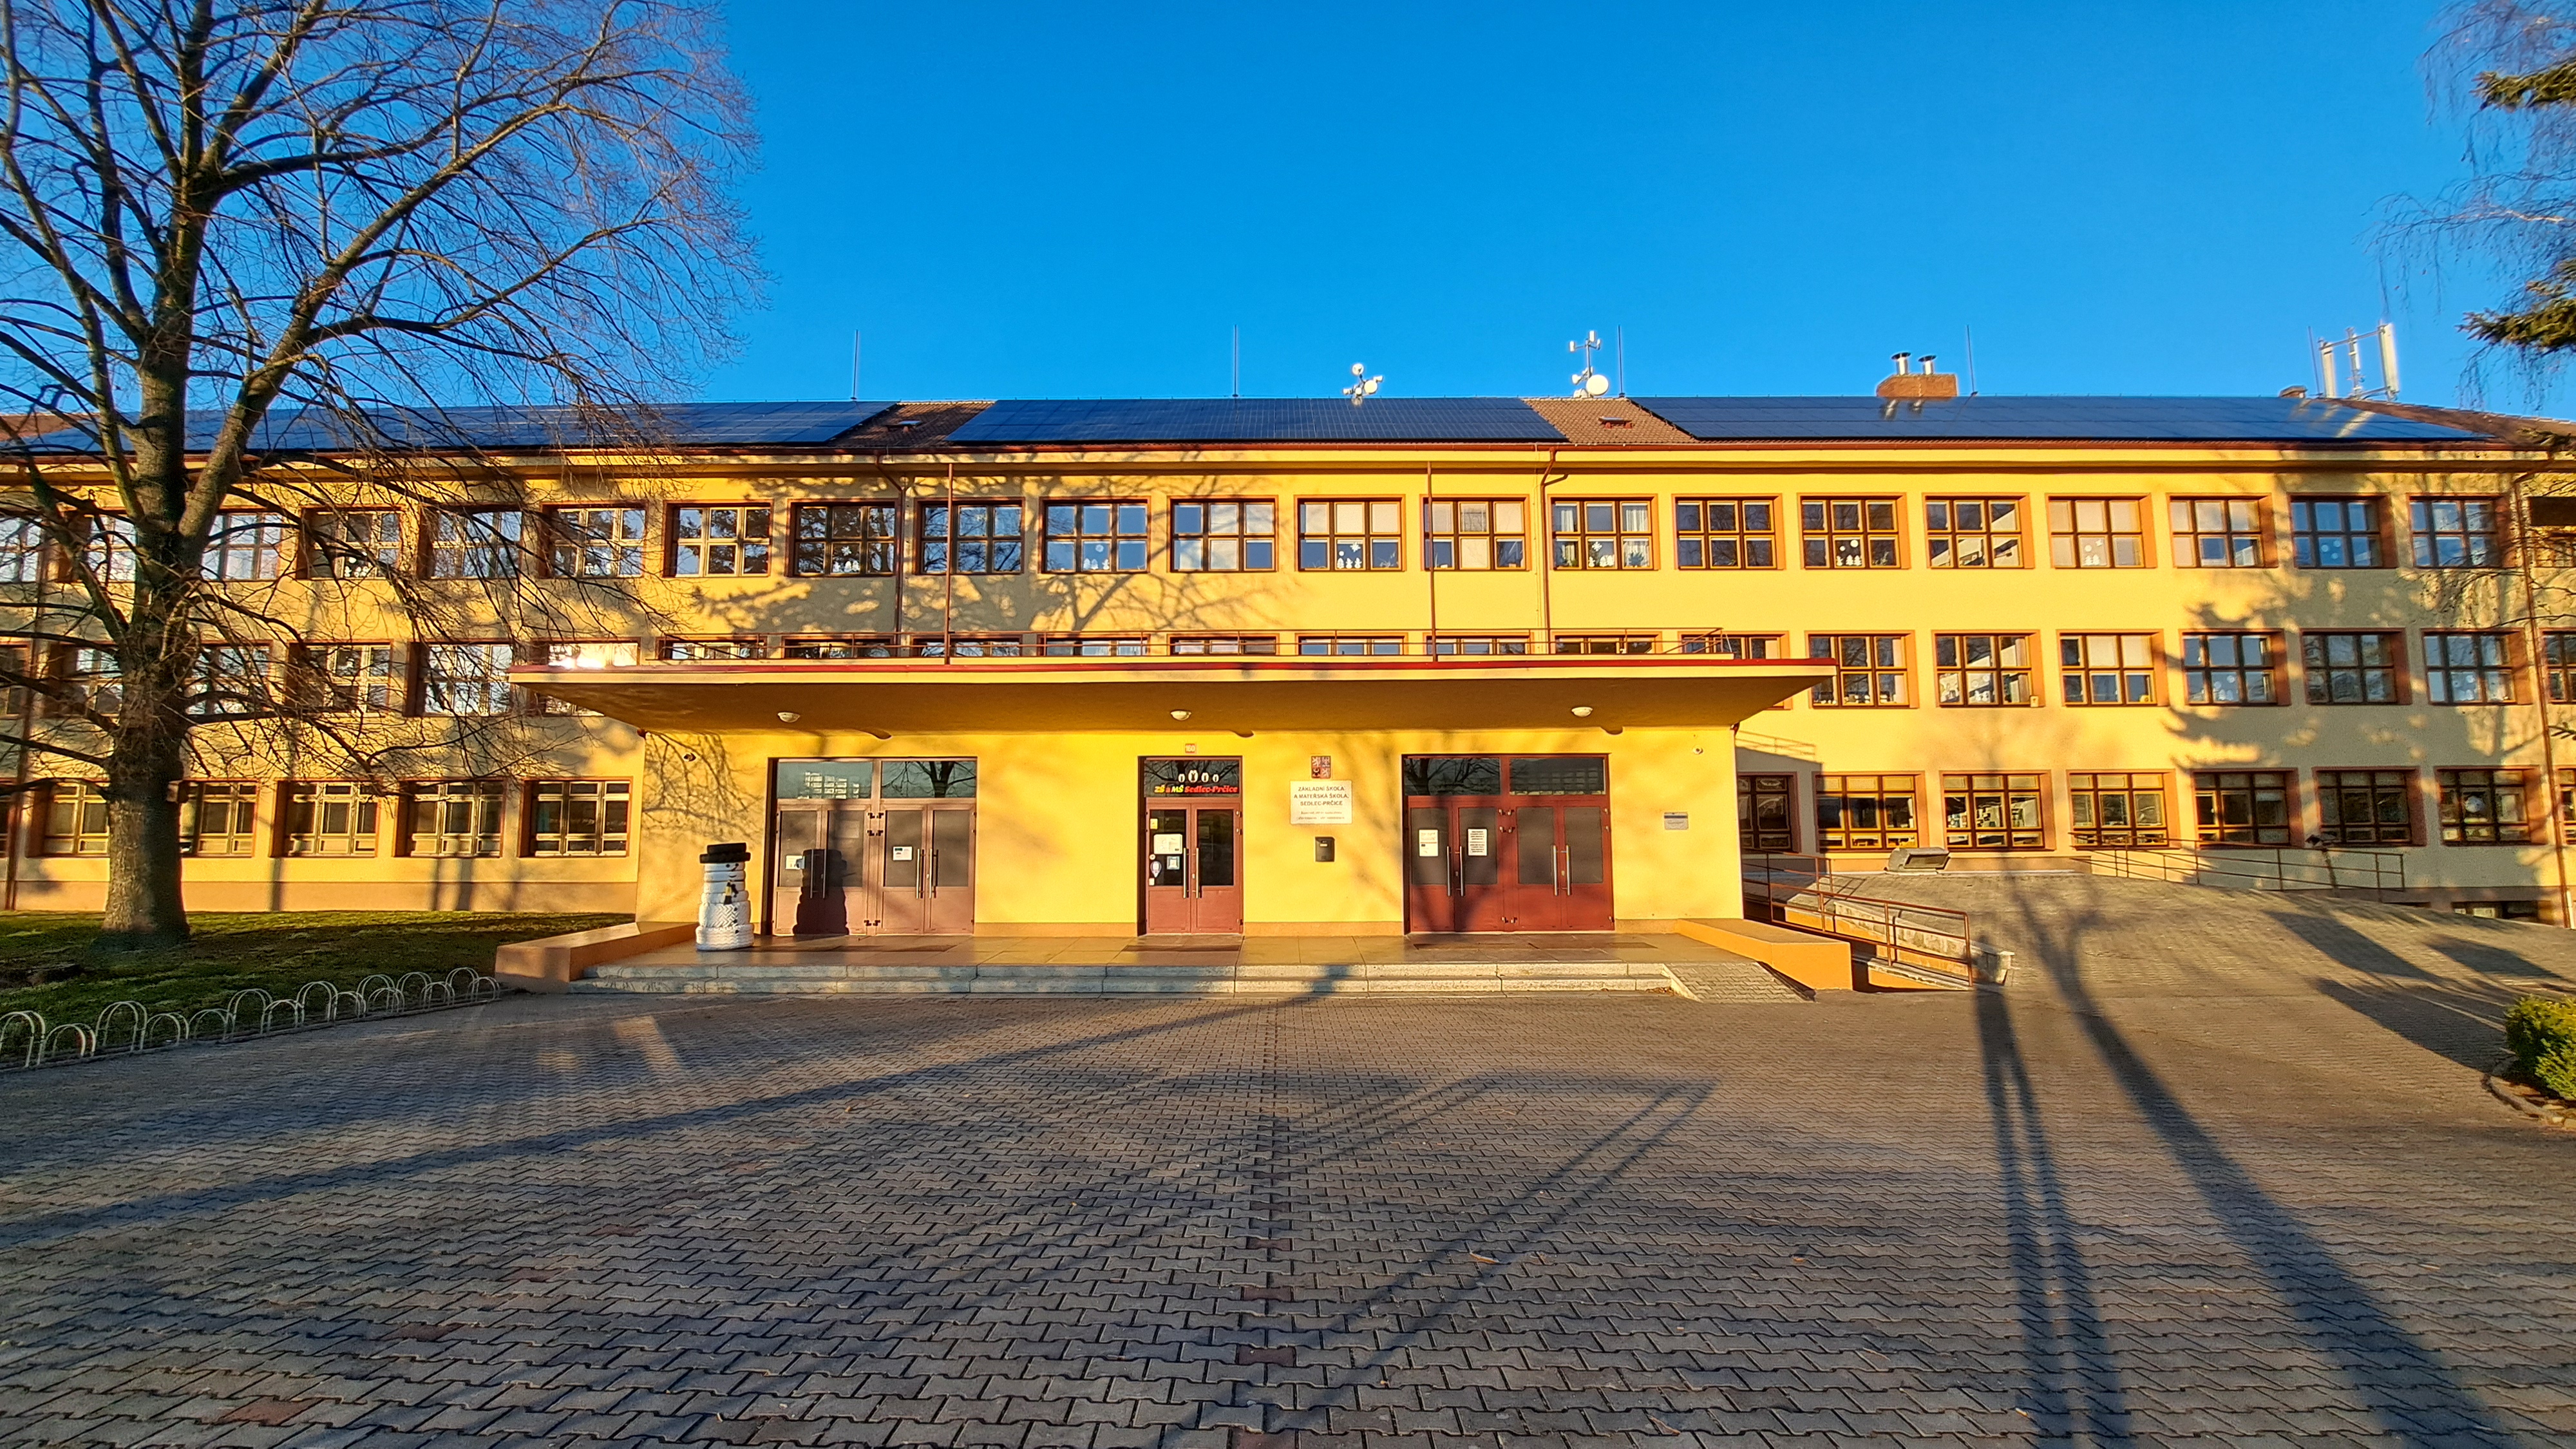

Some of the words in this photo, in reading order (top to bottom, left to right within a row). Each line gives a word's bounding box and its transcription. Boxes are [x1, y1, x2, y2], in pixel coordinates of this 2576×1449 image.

[1154, 784, 1165, 793] ZŠ
[1171, 784, 1184, 793] MŠ
[1185, 785, 1238, 793] Sedlec-Prčice
